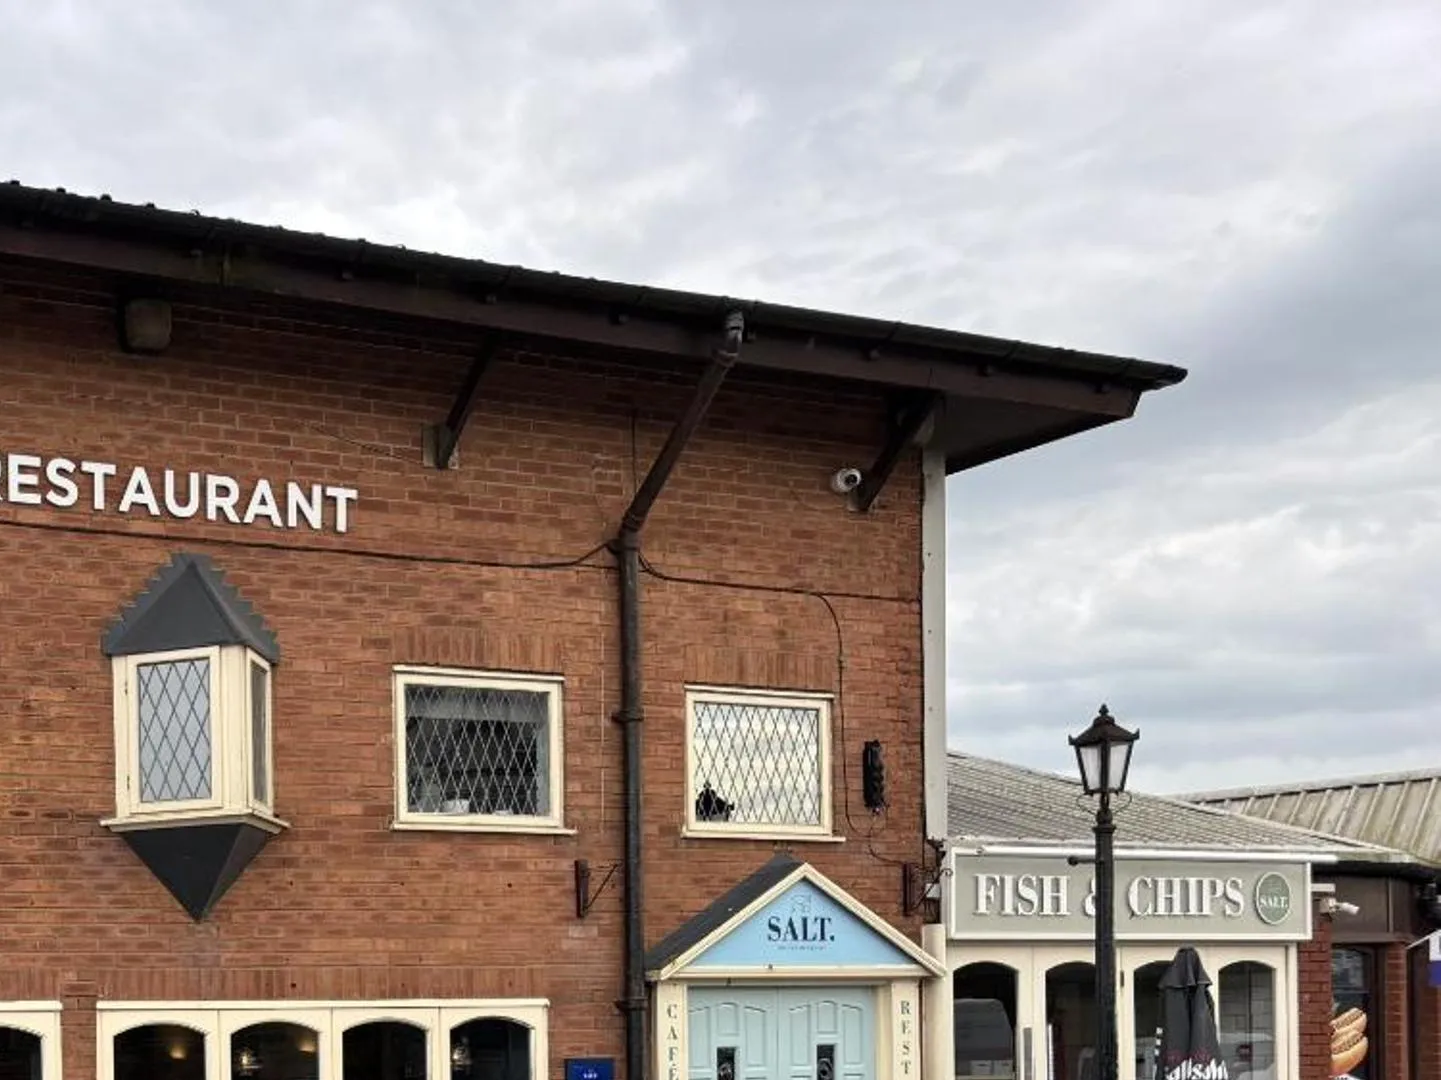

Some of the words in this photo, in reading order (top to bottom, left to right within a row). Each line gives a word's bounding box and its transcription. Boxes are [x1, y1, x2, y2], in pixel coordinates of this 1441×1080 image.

[973, 873, 1071, 916] FISH
[1127, 876, 1245, 917] CHIPS
[767, 916, 835, 941] SALT.
